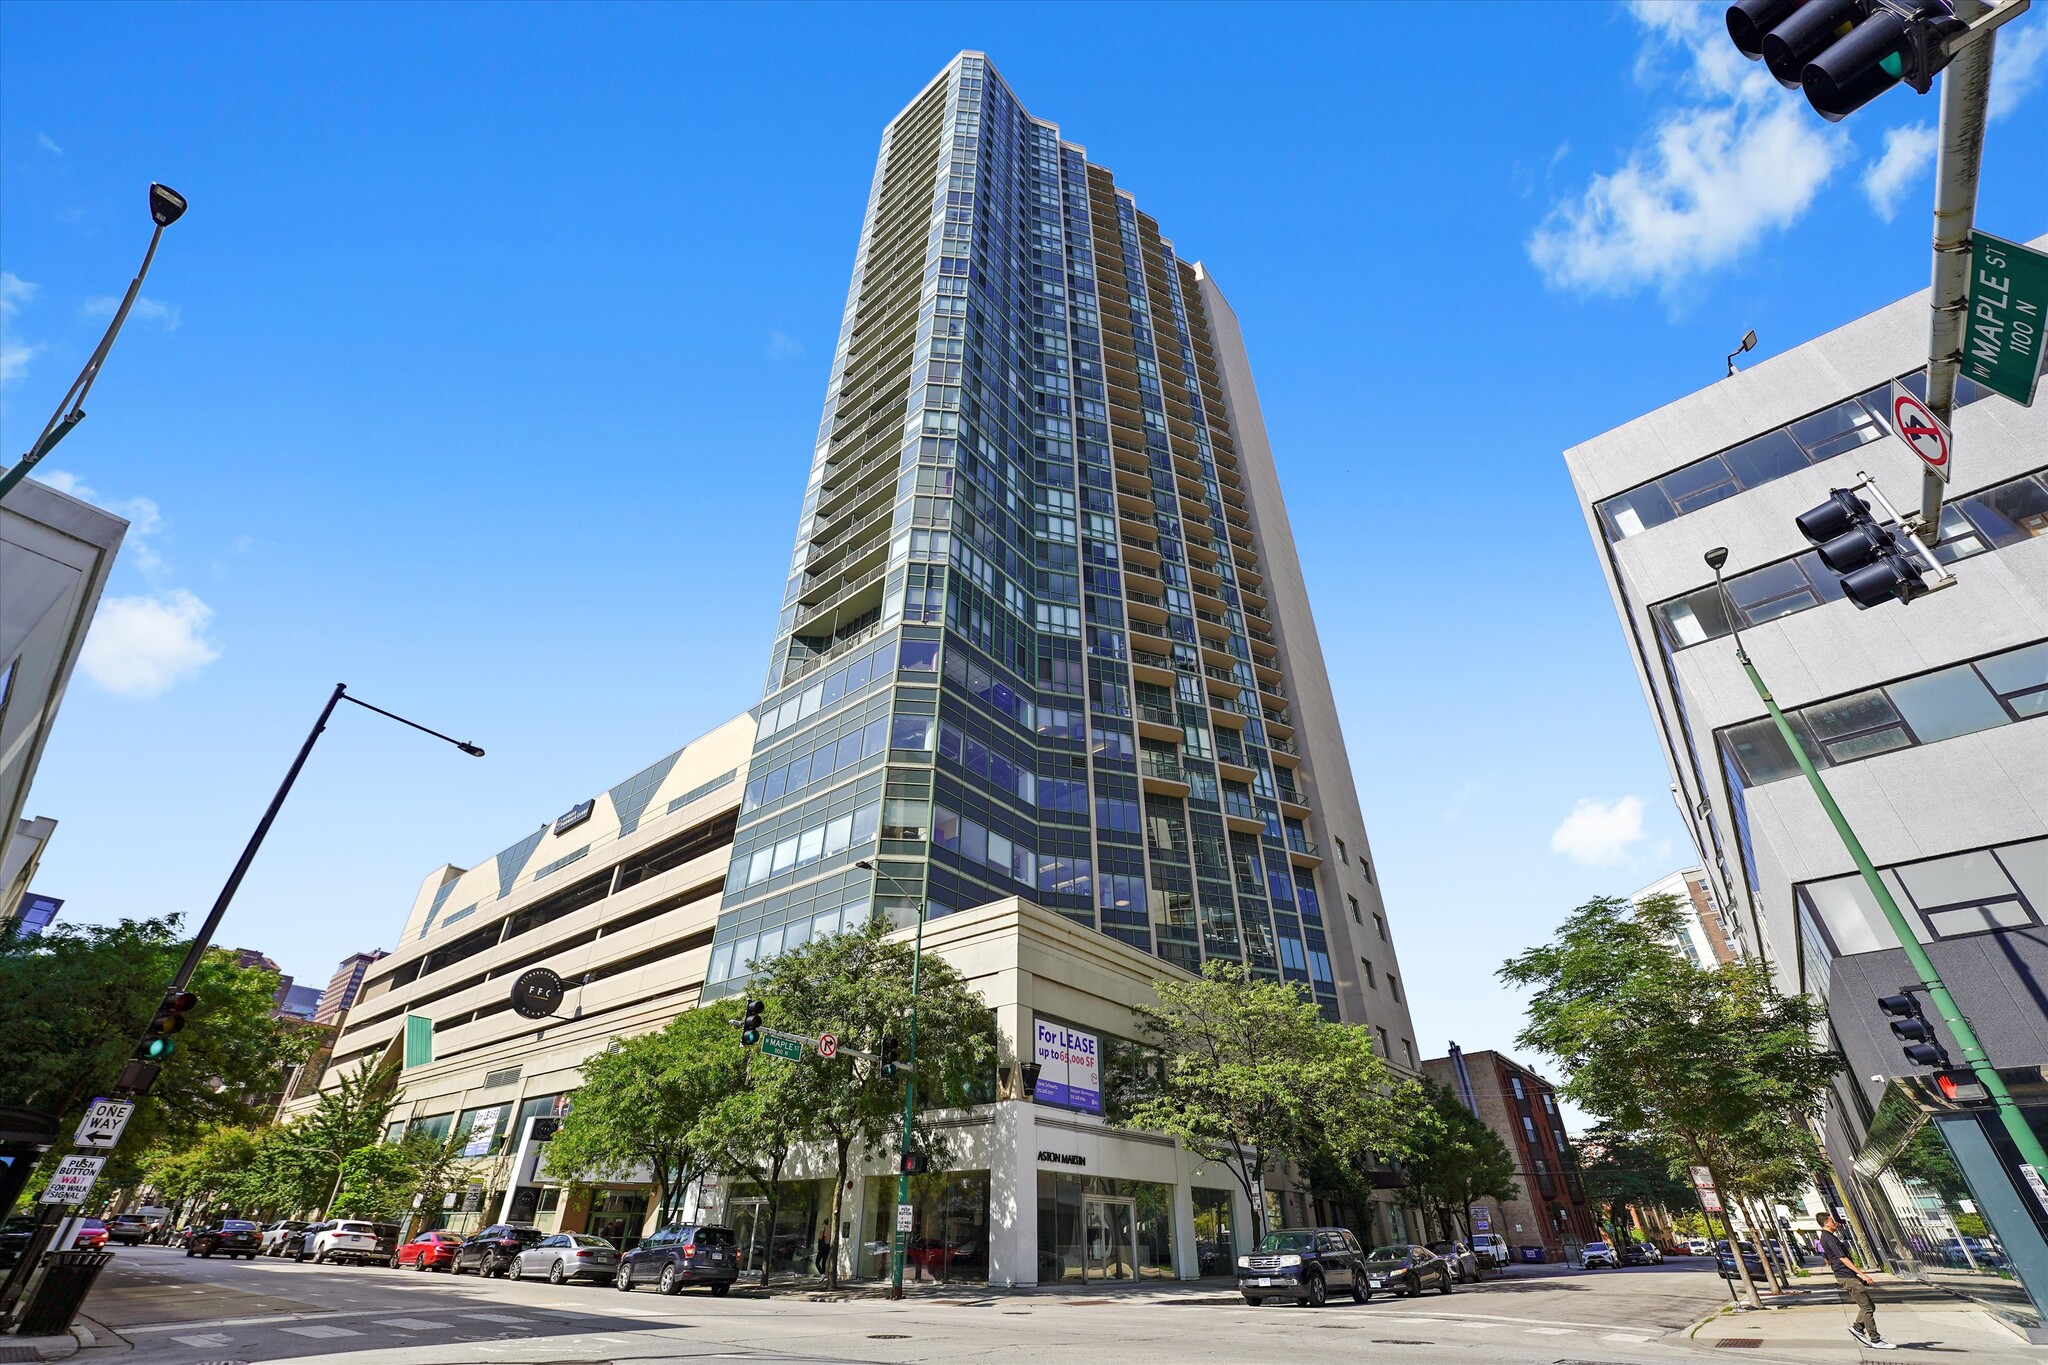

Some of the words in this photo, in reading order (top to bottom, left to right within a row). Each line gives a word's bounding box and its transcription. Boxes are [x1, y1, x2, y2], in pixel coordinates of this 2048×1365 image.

[1985, 243, 2007, 269] ST
[2015, 299, 2038, 317] N
[1971, 269, 2010, 365] MAPLE
[2009, 320, 2034, 356] 1100
[1972, 362, 1992, 379] W
[528, 985, 551, 997] FFC
[769, 1038, 793, 1051] MAPLE
[1038, 1025, 1057, 1045] For
[1060, 1031, 1095, 1055] LEASE
[1038, 1047, 1050, 1059] up
[1051, 1048, 1060, 1060] to
[1059, 1050, 1085, 1065] 65,000
[1085, 1056, 1095, 1068] SF
[96, 1105, 127, 1118] ONE
[90, 1117, 122, 1130] WAY
[69, 1160, 96, 1169] PUSH
[1037, 1151, 1061, 1163] ASTON
[1061, 1154, 1086, 1166] MARTIN
[59, 1167, 97, 1177] BUTTON
[61, 1176, 87, 1184] WAIT
[67, 1184, 88, 1192] WALK
[49, 1192, 79, 1200] SIGNAL
[466, 1192, 479, 1201] 25
